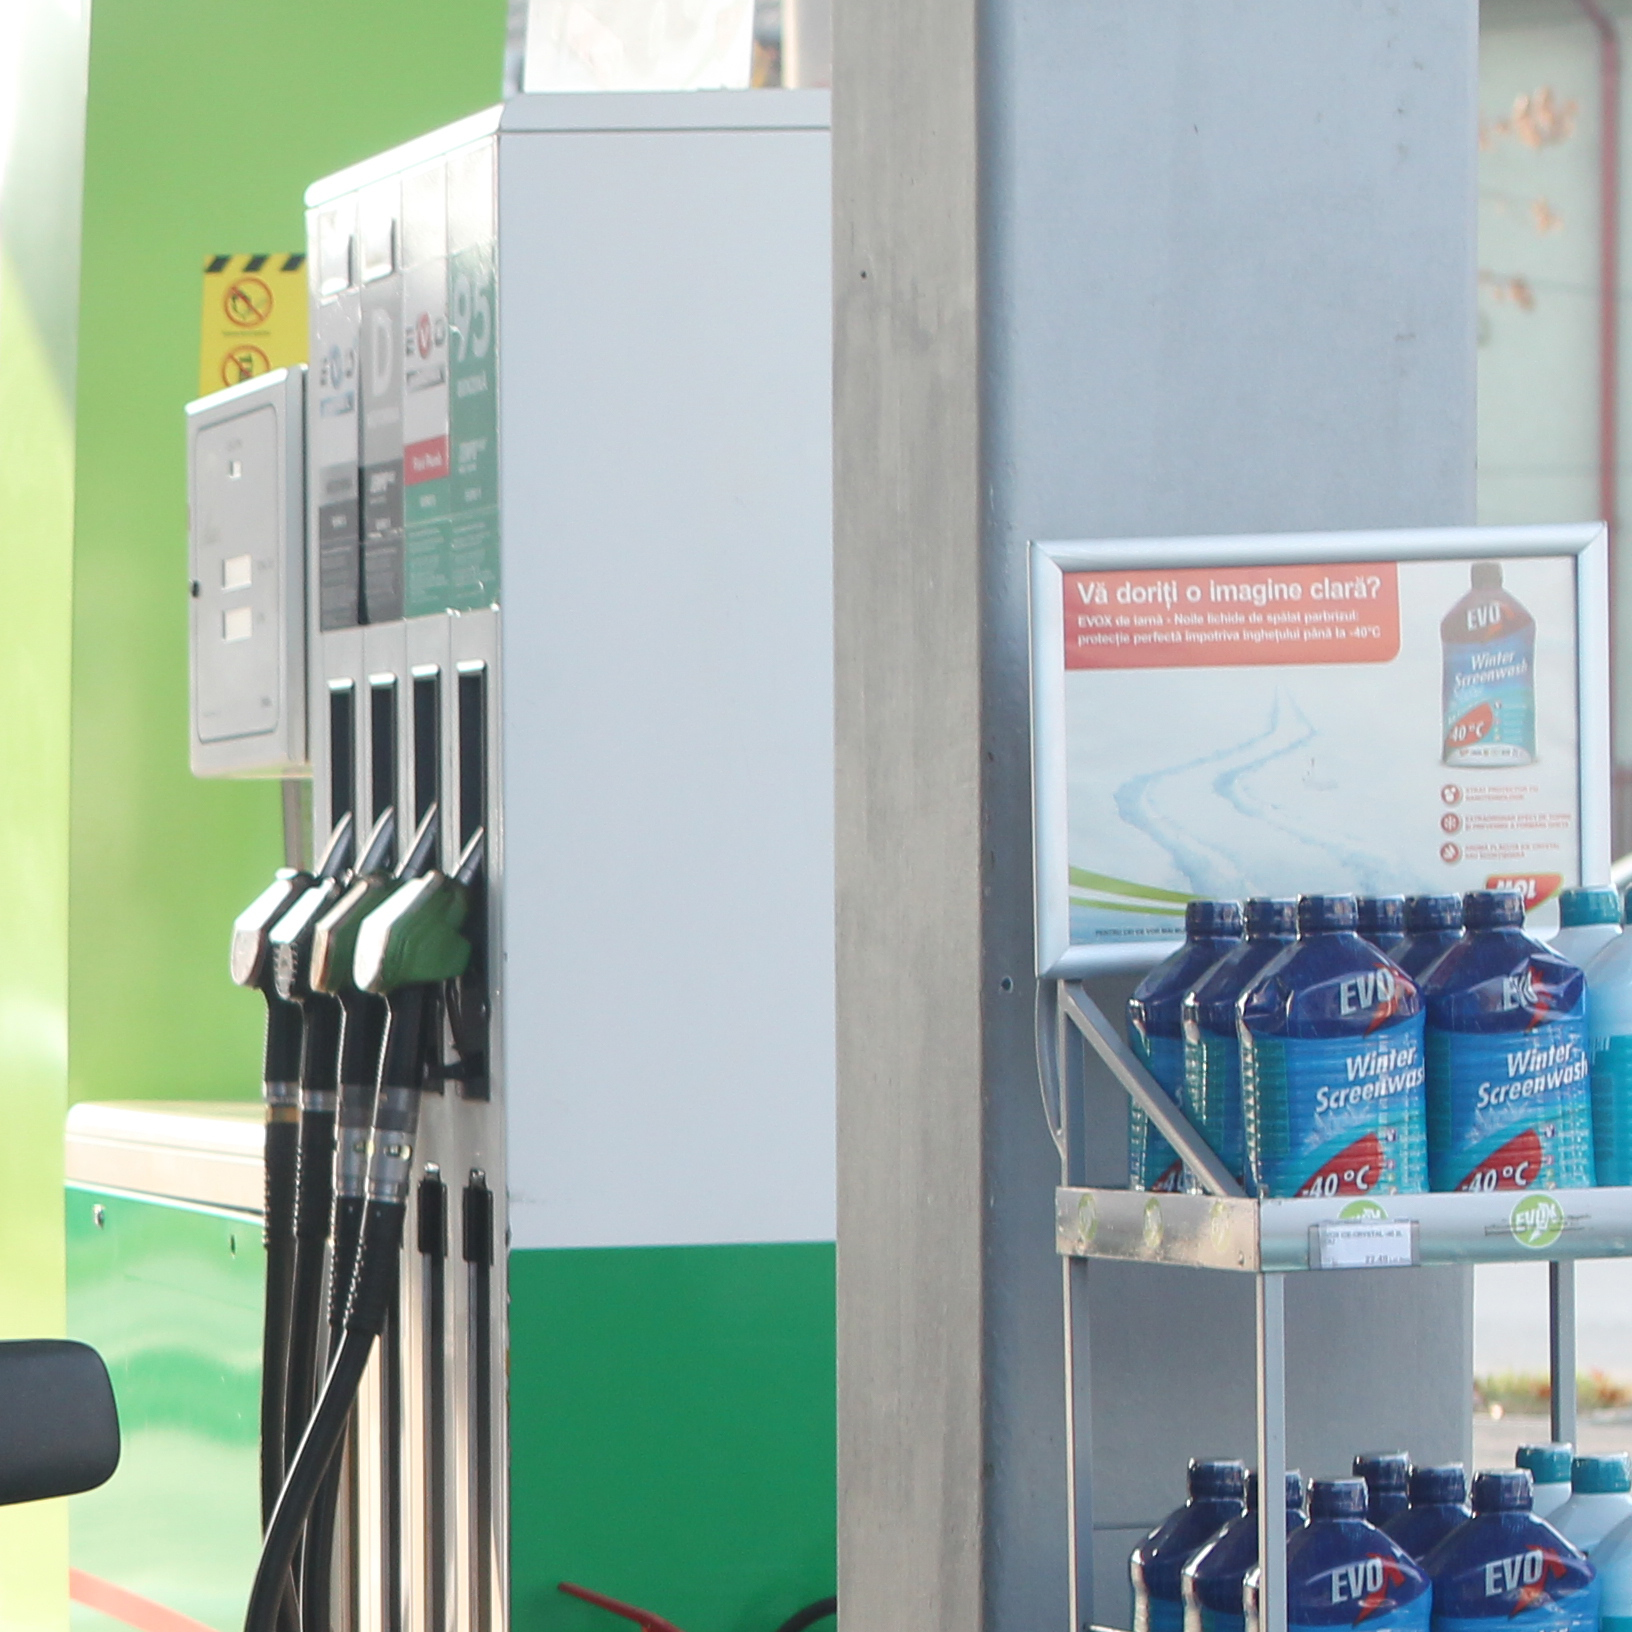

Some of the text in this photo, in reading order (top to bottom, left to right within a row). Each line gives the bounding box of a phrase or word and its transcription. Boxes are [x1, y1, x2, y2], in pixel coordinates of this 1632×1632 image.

[1077, 582, 1108, 604] Vă
[1186, 584, 1201, 602] o
[1210, 579, 1301, 606] imagine
[1310, 576, 1381, 600] clară?
[1346, 1046, 1416, 1081] Winter
[1507, 1041, 1571, 1078] Winter
[1477, 1052, 1588, 1109] Screenwash
